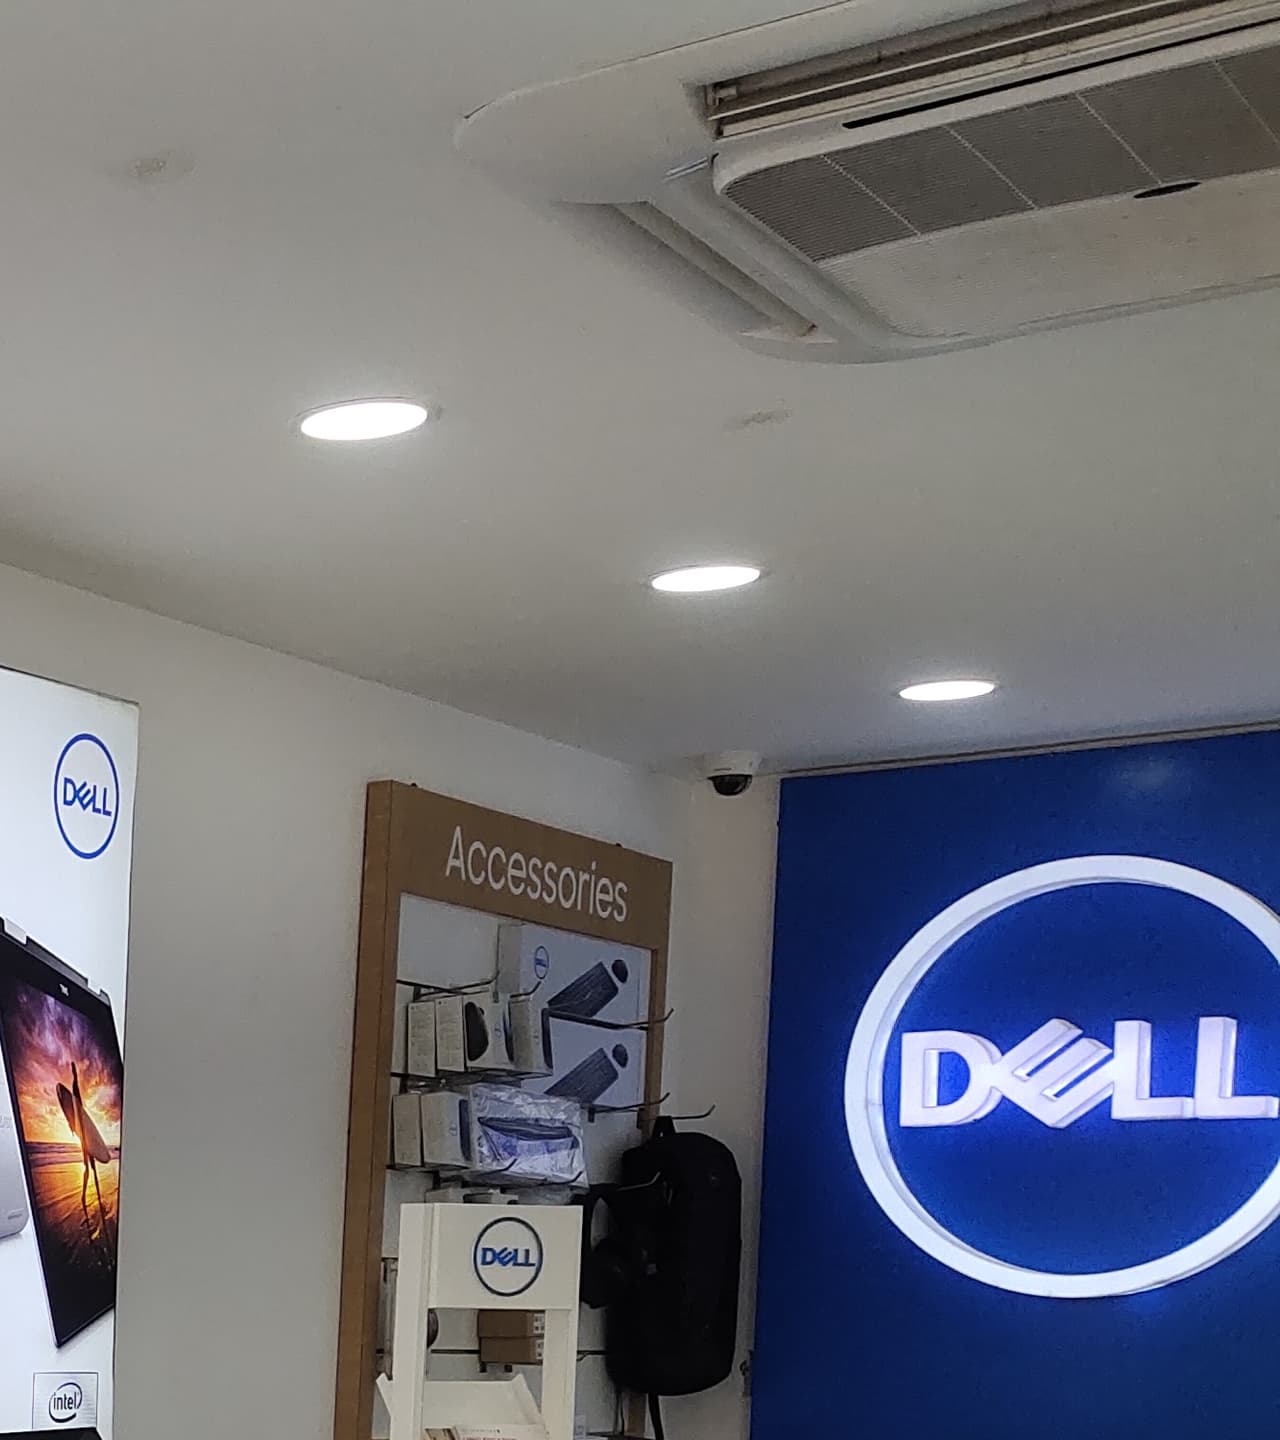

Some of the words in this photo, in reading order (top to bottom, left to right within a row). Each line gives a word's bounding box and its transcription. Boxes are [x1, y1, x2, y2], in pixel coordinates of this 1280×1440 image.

[62, 777, 112, 818] DELL
[445, 826, 629, 923] Accessories
[900, 1015, 1280, 1129] DELL
[481, 1246, 537, 1268] DELL
[52, 1391, 79, 1412] intel
